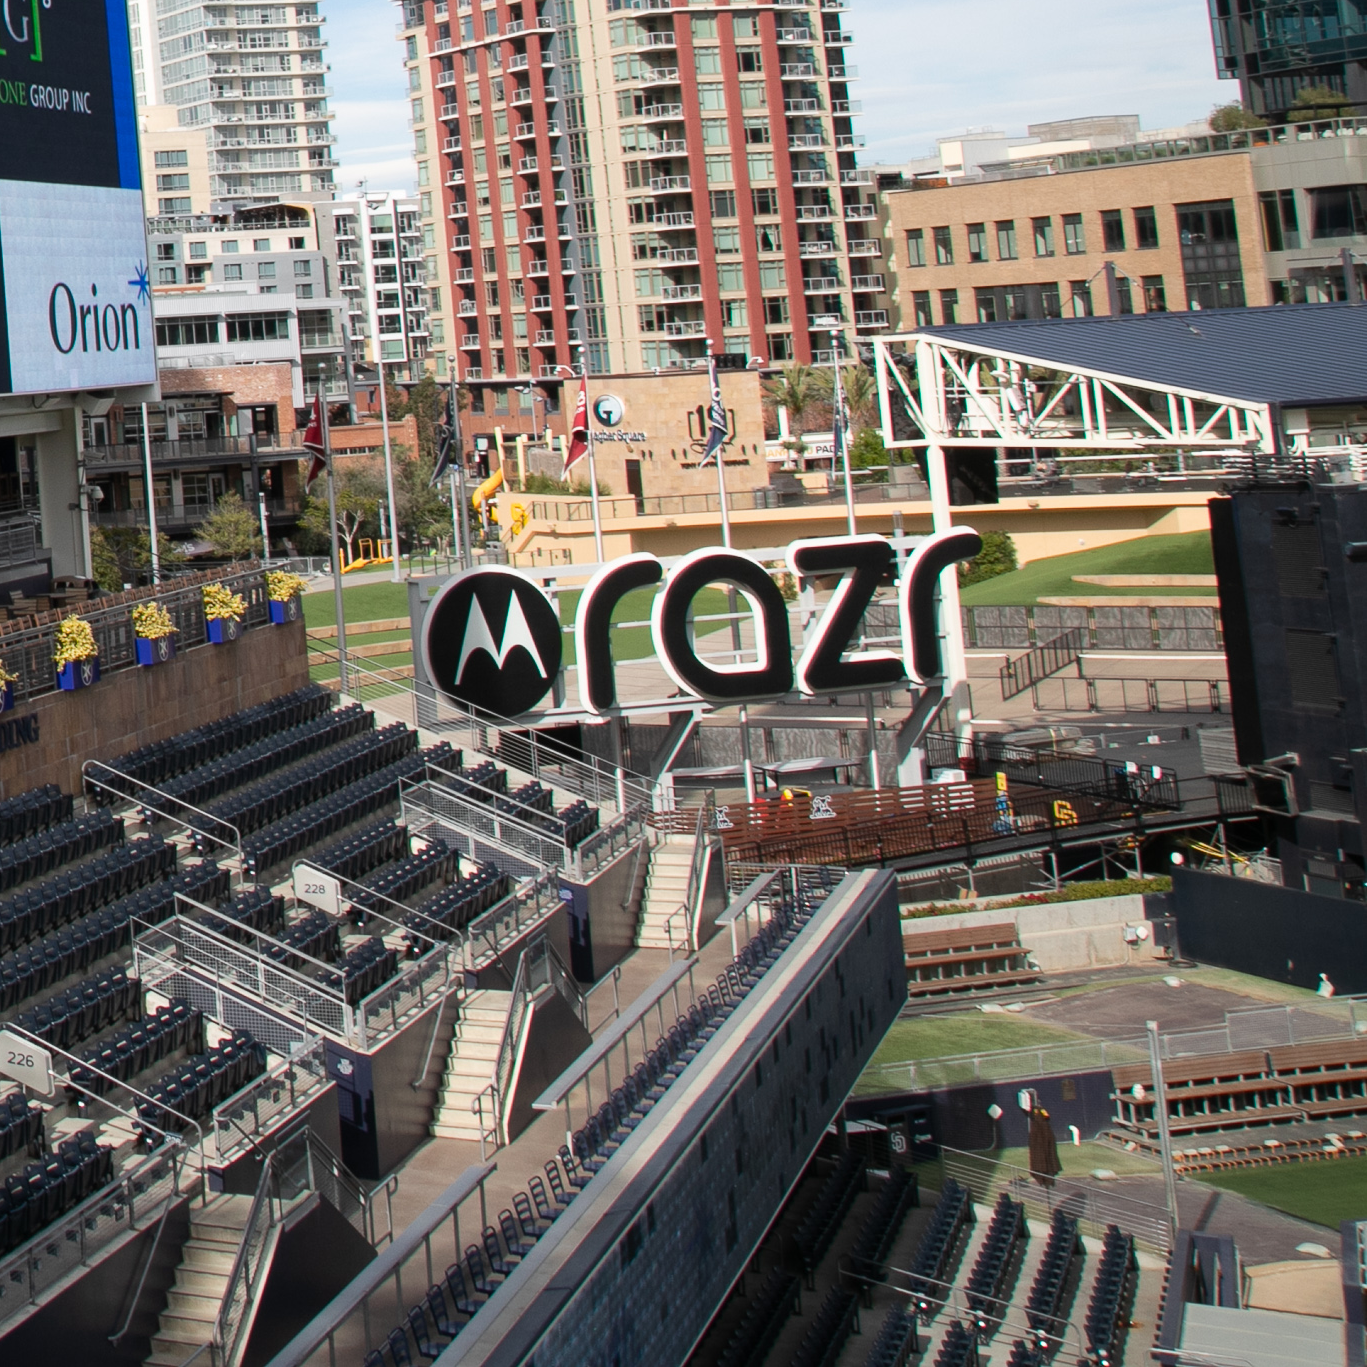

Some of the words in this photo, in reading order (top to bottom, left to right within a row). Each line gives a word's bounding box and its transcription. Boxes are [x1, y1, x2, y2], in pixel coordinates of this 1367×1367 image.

[30, 84, 69, 111] GROUP
[71, 90, 91, 114] INC
[49, 283, 141, 354] Orion
[574, 525, 984, 715] razr
[304, 882, 326, 895] 228
[7, 1050, 35, 1069] 226
